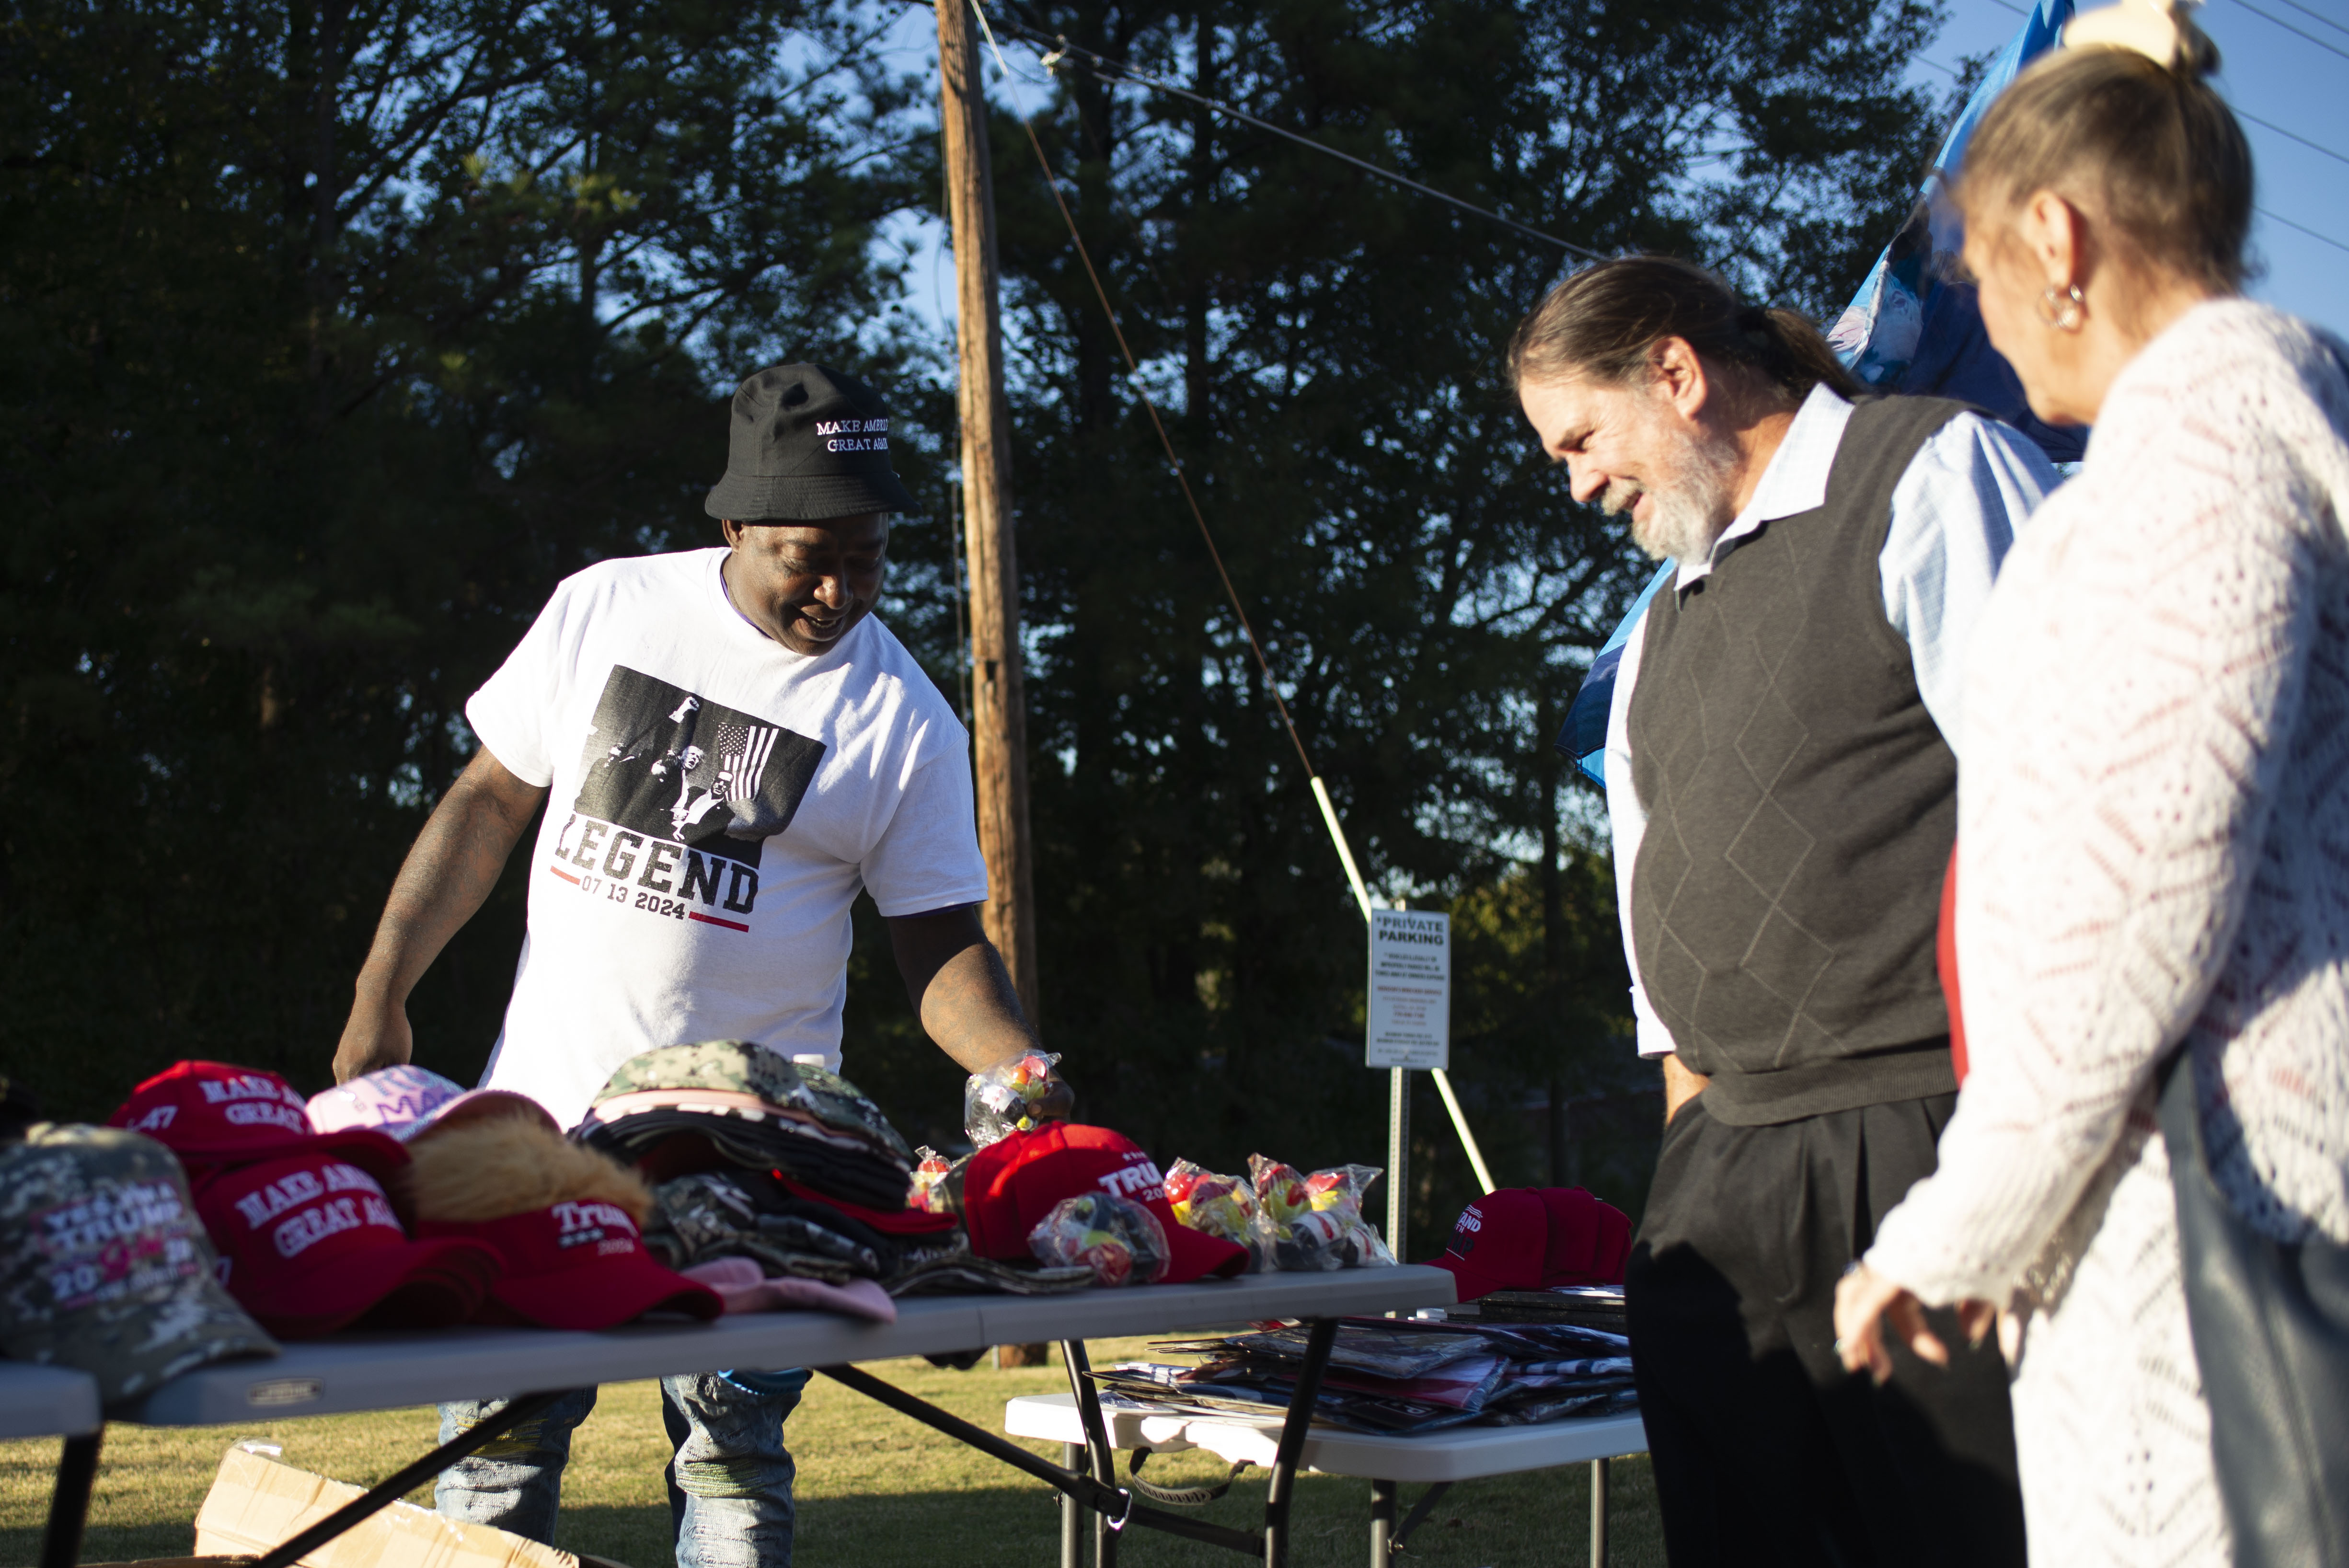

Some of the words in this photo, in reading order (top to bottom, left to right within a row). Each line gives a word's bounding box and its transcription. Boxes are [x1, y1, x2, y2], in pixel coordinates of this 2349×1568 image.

[817, 420, 861, 435] MAKE
[863, 418, 889, 432] AMERIC
[828, 438, 871, 452] GREAT
[555, 814, 759, 914] LEGEND
[581, 875, 602, 894] 07
[607, 883, 629, 903] 13
[635, 892, 685, 920] 2024
[1379, 930, 1444, 945] PARKING
[198, 1075, 281, 1104] MAKE
[225, 1102, 305, 1135] GREAT
[1098, 1161, 1165, 1198] TRU
[235, 1170, 324, 1231] MAKE
[273, 1197, 362, 1259] GREAT
